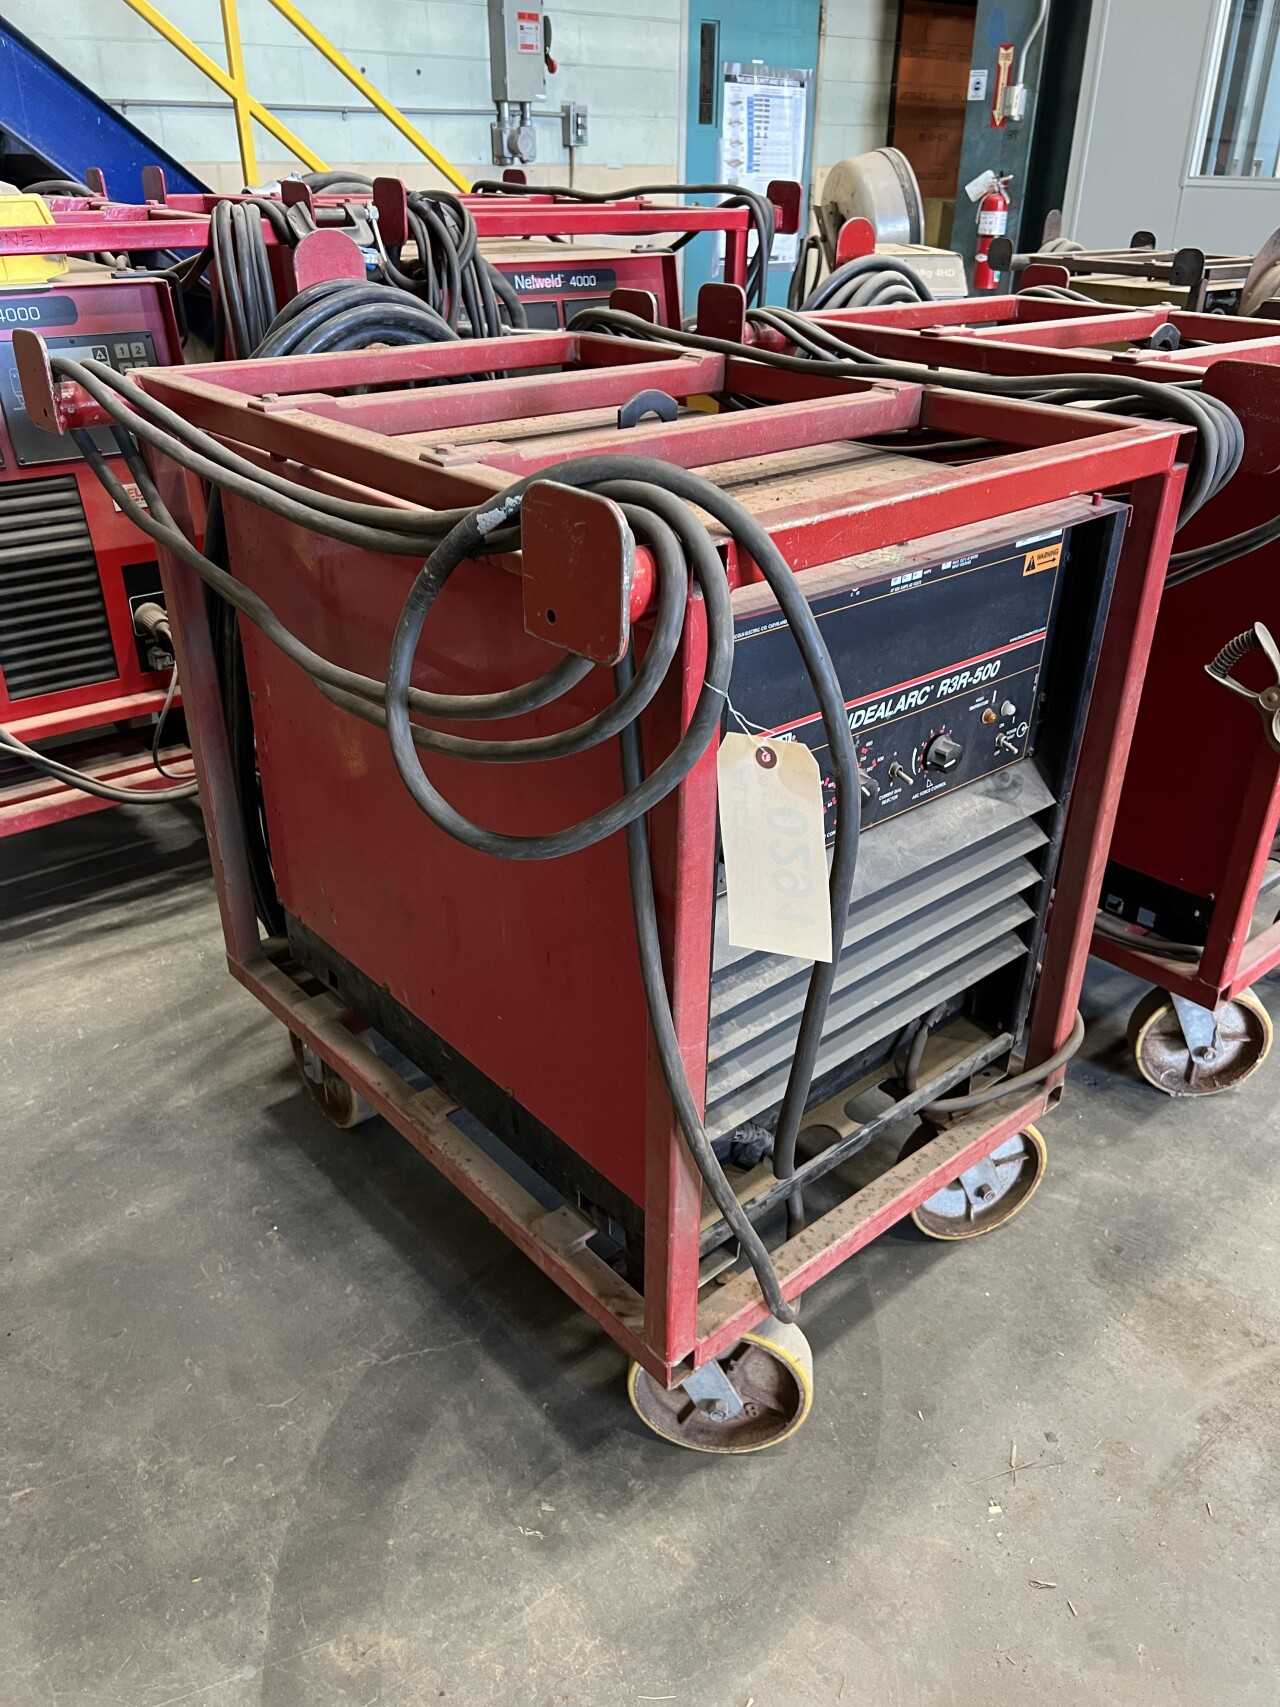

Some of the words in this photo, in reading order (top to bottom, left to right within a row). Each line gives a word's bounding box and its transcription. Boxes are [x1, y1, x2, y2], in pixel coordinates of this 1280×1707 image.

[514, 274, 561, 289] Nelweld
[569, 275, 597, 287] 4000
[849, 687, 931, 730] IDEALARC
[937, 660, 1001, 698] R3R-500
